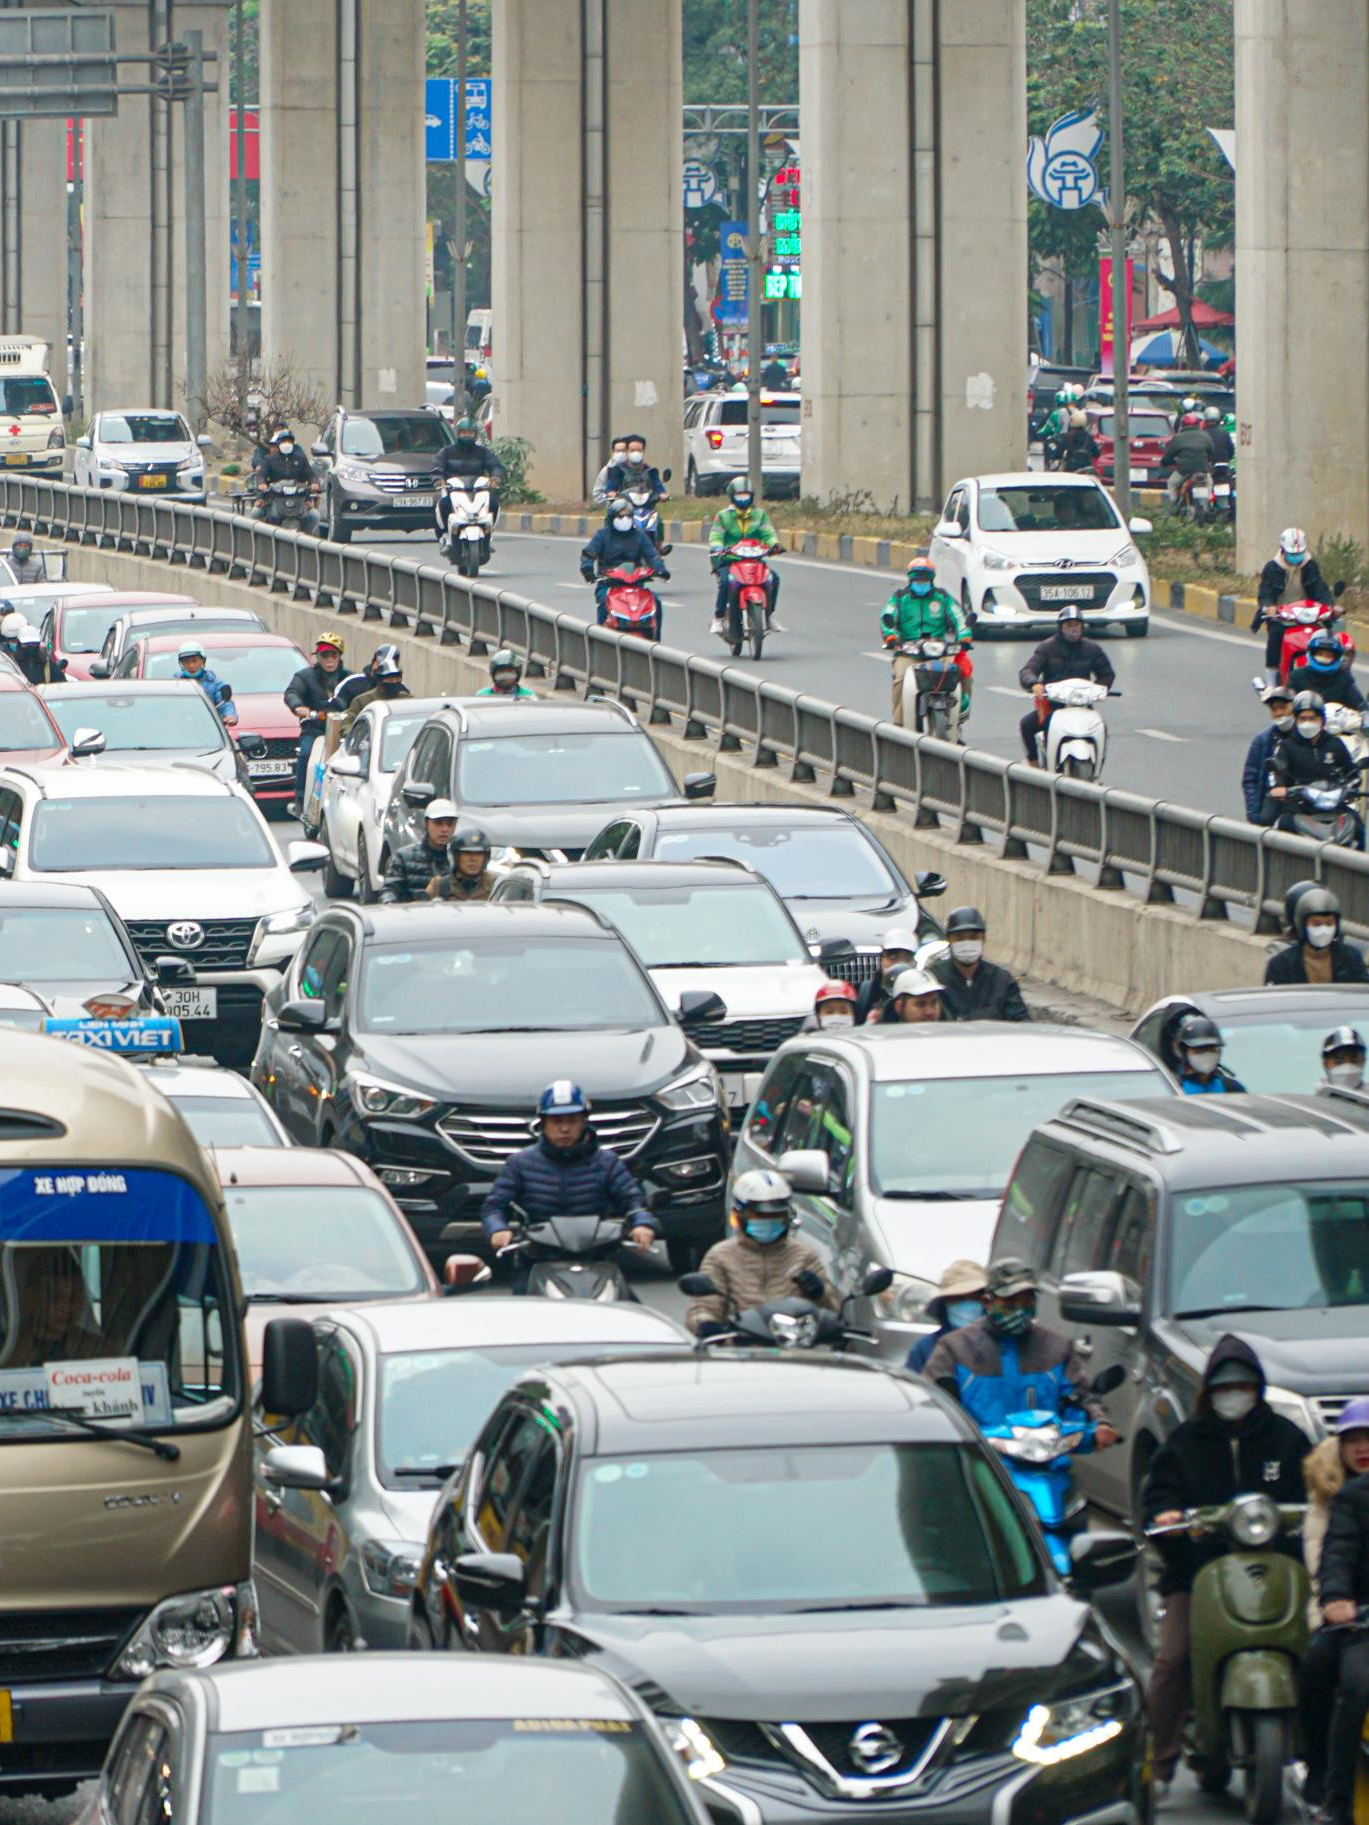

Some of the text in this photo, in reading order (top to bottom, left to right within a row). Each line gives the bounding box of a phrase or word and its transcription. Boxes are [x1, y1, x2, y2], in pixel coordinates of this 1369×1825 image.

[175, 991, 199, 1003] 30H
[168, 1005, 210, 1017] 05.44
[34, 1176, 55, 1194] XE
[51, 1367, 131, 1386] Coca-cola
